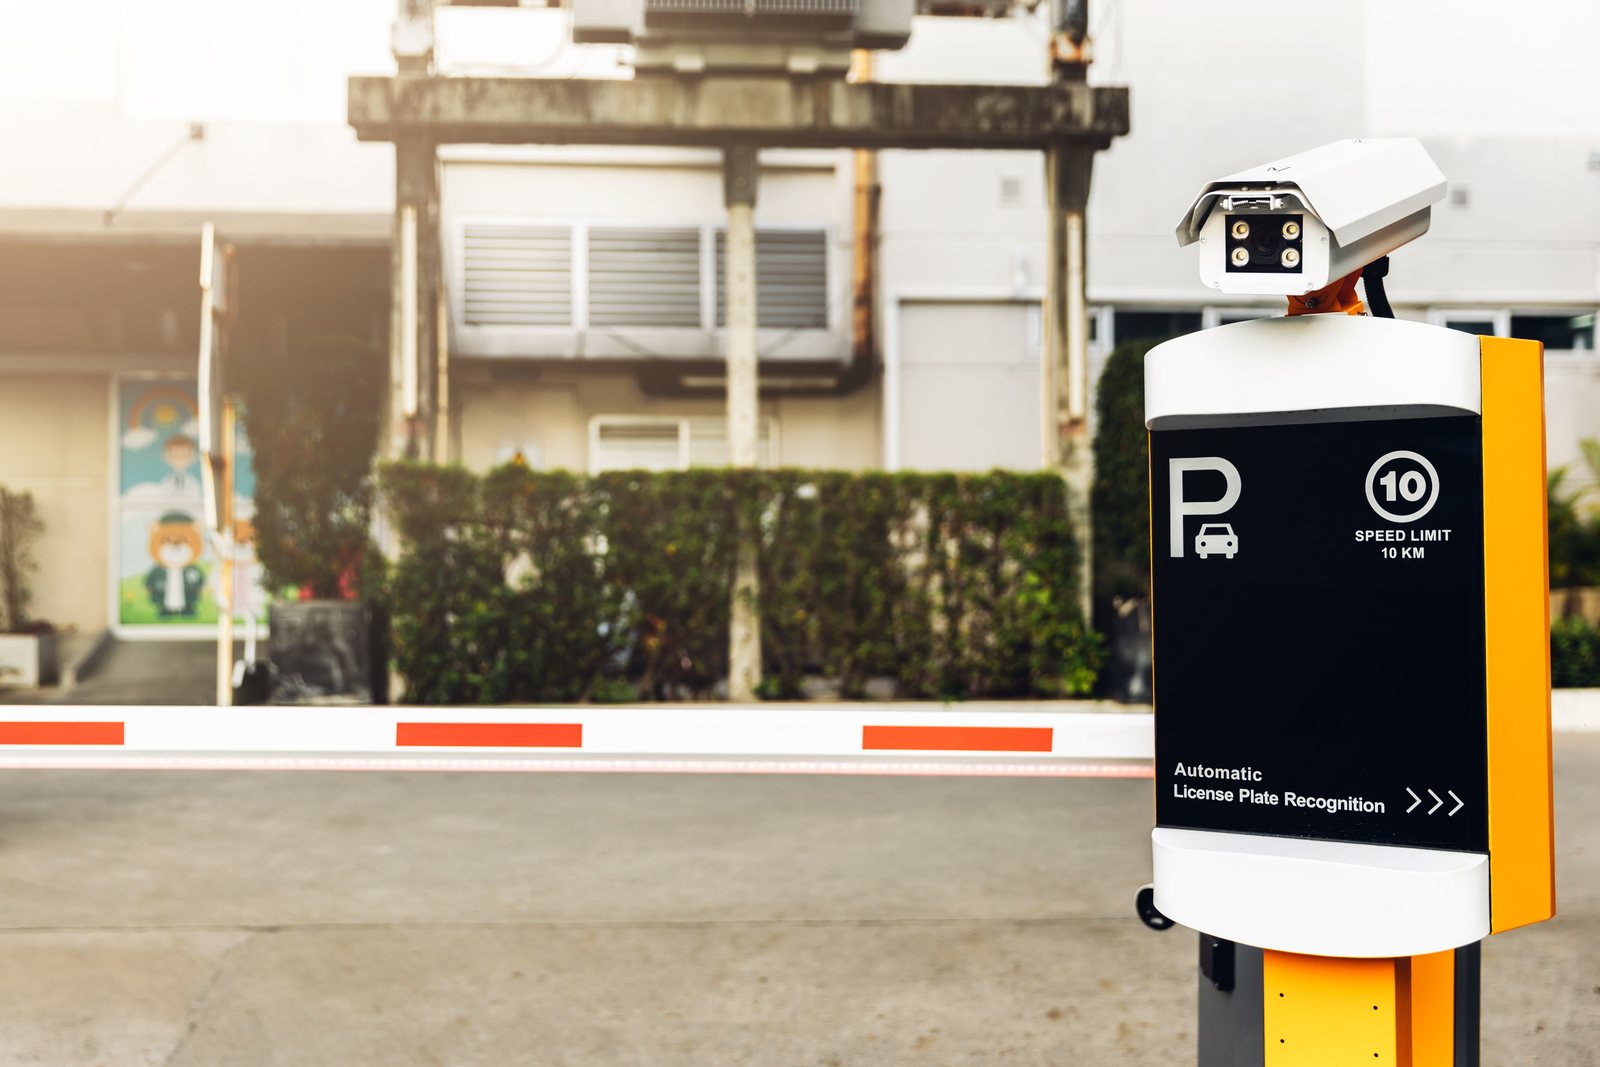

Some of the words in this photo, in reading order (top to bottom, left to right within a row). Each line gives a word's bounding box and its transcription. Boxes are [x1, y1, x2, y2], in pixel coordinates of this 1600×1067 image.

[1379, 470, 1427, 502] 10
[1169, 456, 1242, 558] P
[1354, 529, 1406, 542] SPEED
[1410, 529, 1452, 542] LIMIT
[1381, 546, 1398, 559] 10
[1401, 546, 1425, 559] KM
[1174, 762, 1263, 782] Automatic
[1173, 783, 1234, 802] License
[1239, 788, 1279, 806] Plate
[1284, 791, 1385, 814] Recognition
